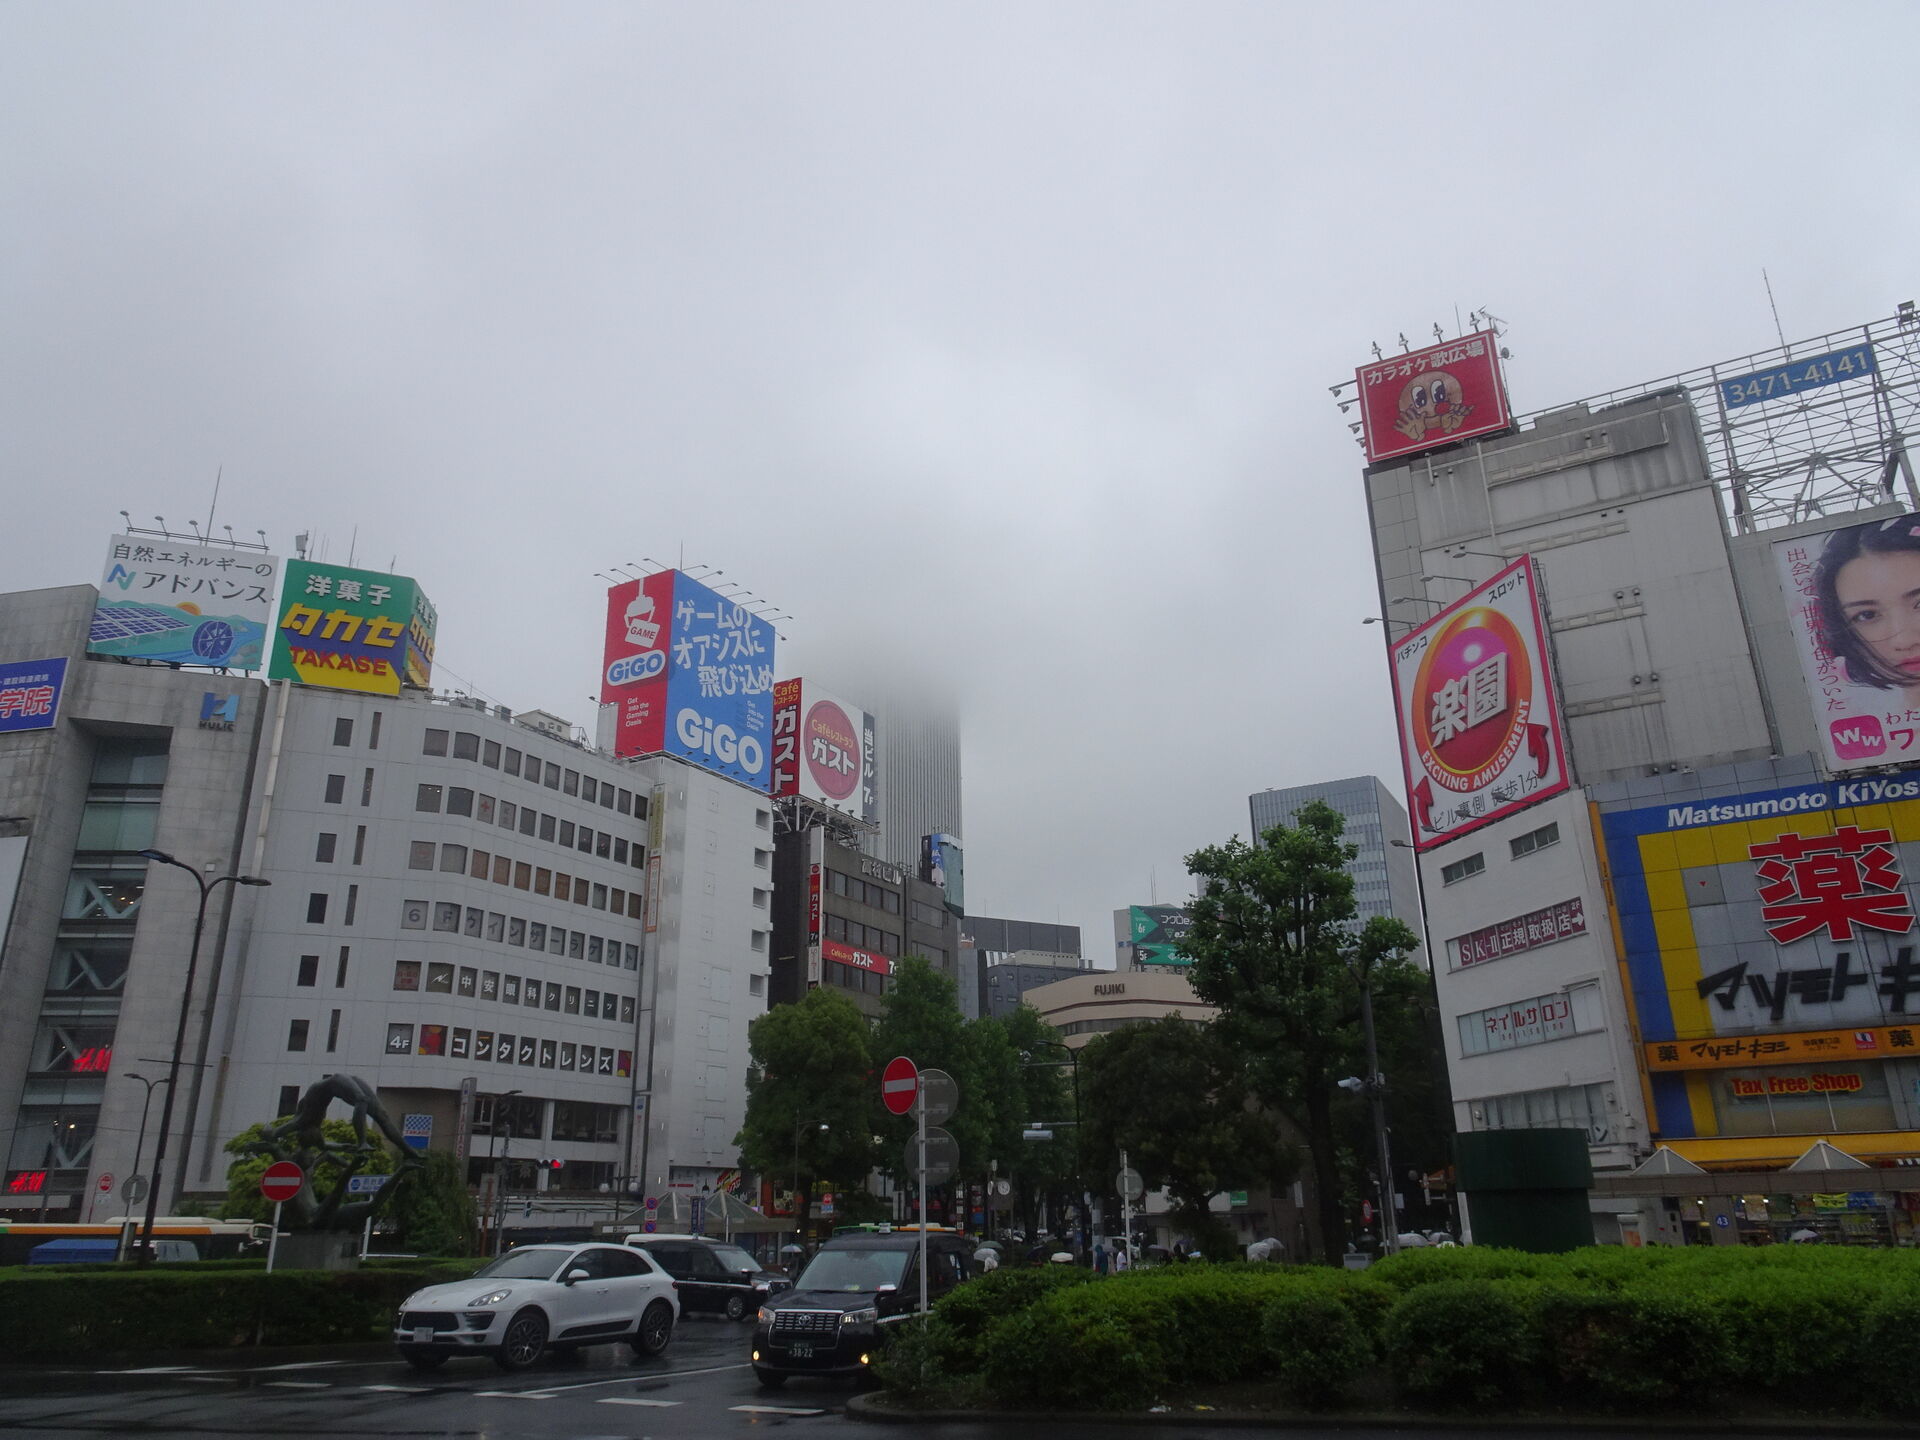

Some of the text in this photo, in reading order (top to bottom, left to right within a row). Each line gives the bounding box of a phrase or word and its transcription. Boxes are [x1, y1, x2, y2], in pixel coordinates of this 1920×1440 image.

[1368, 340, 1485, 386] カラオケ歌広場
[1729, 351, 1867, 404] 3471-4141
[113, 542, 273, 577] 自然エネルギーの
[142, 571, 268, 604] アドバンス
[304, 573, 393, 606] 洋菓子
[1487, 573, 1526, 604] スロット
[280, 602, 406, 650] タカセ
[676, 599, 753, 632] ゲームの
[630, 625, 657, 641] GAME
[673, 628, 766, 670] オアシスに
[1396, 635, 1428, 665] パチンコ
[289, 645, 389, 677] TAKASE
[608, 652, 664, 683] GiGO
[697, 664, 775, 698] 飛び込め
[773, 681, 799, 697] Café
[1430, 652, 1508, 749] 楽園
[675, 707, 764, 775] GiGO
[773, 704, 797, 795] ガスト
[811, 736, 856, 777] ガスト
[1421, 698, 1531, 793] EXCITING AMUSEMENT
[1667, 792, 1828, 828] Matsumoto
[1747, 825, 1916, 946] 薬
[1501, 914, 1571, 950] 正規取扱店
[852, 951, 874, 968] ガスト
[460, 974, 631, 1016] 中安眼科クリニック
[1093, 983, 1126, 996] FUJIKI
[1485, 1000, 1570, 1034] ネイルサロン
[390, 1035, 613, 1072] 4F コンタクトレンズ
[1690, 1038, 1791, 1061] マツモトキヨシ
[1730, 1072, 1863, 1096] Tax Free Shop
[1716, 1216, 1729, 1227] 43
